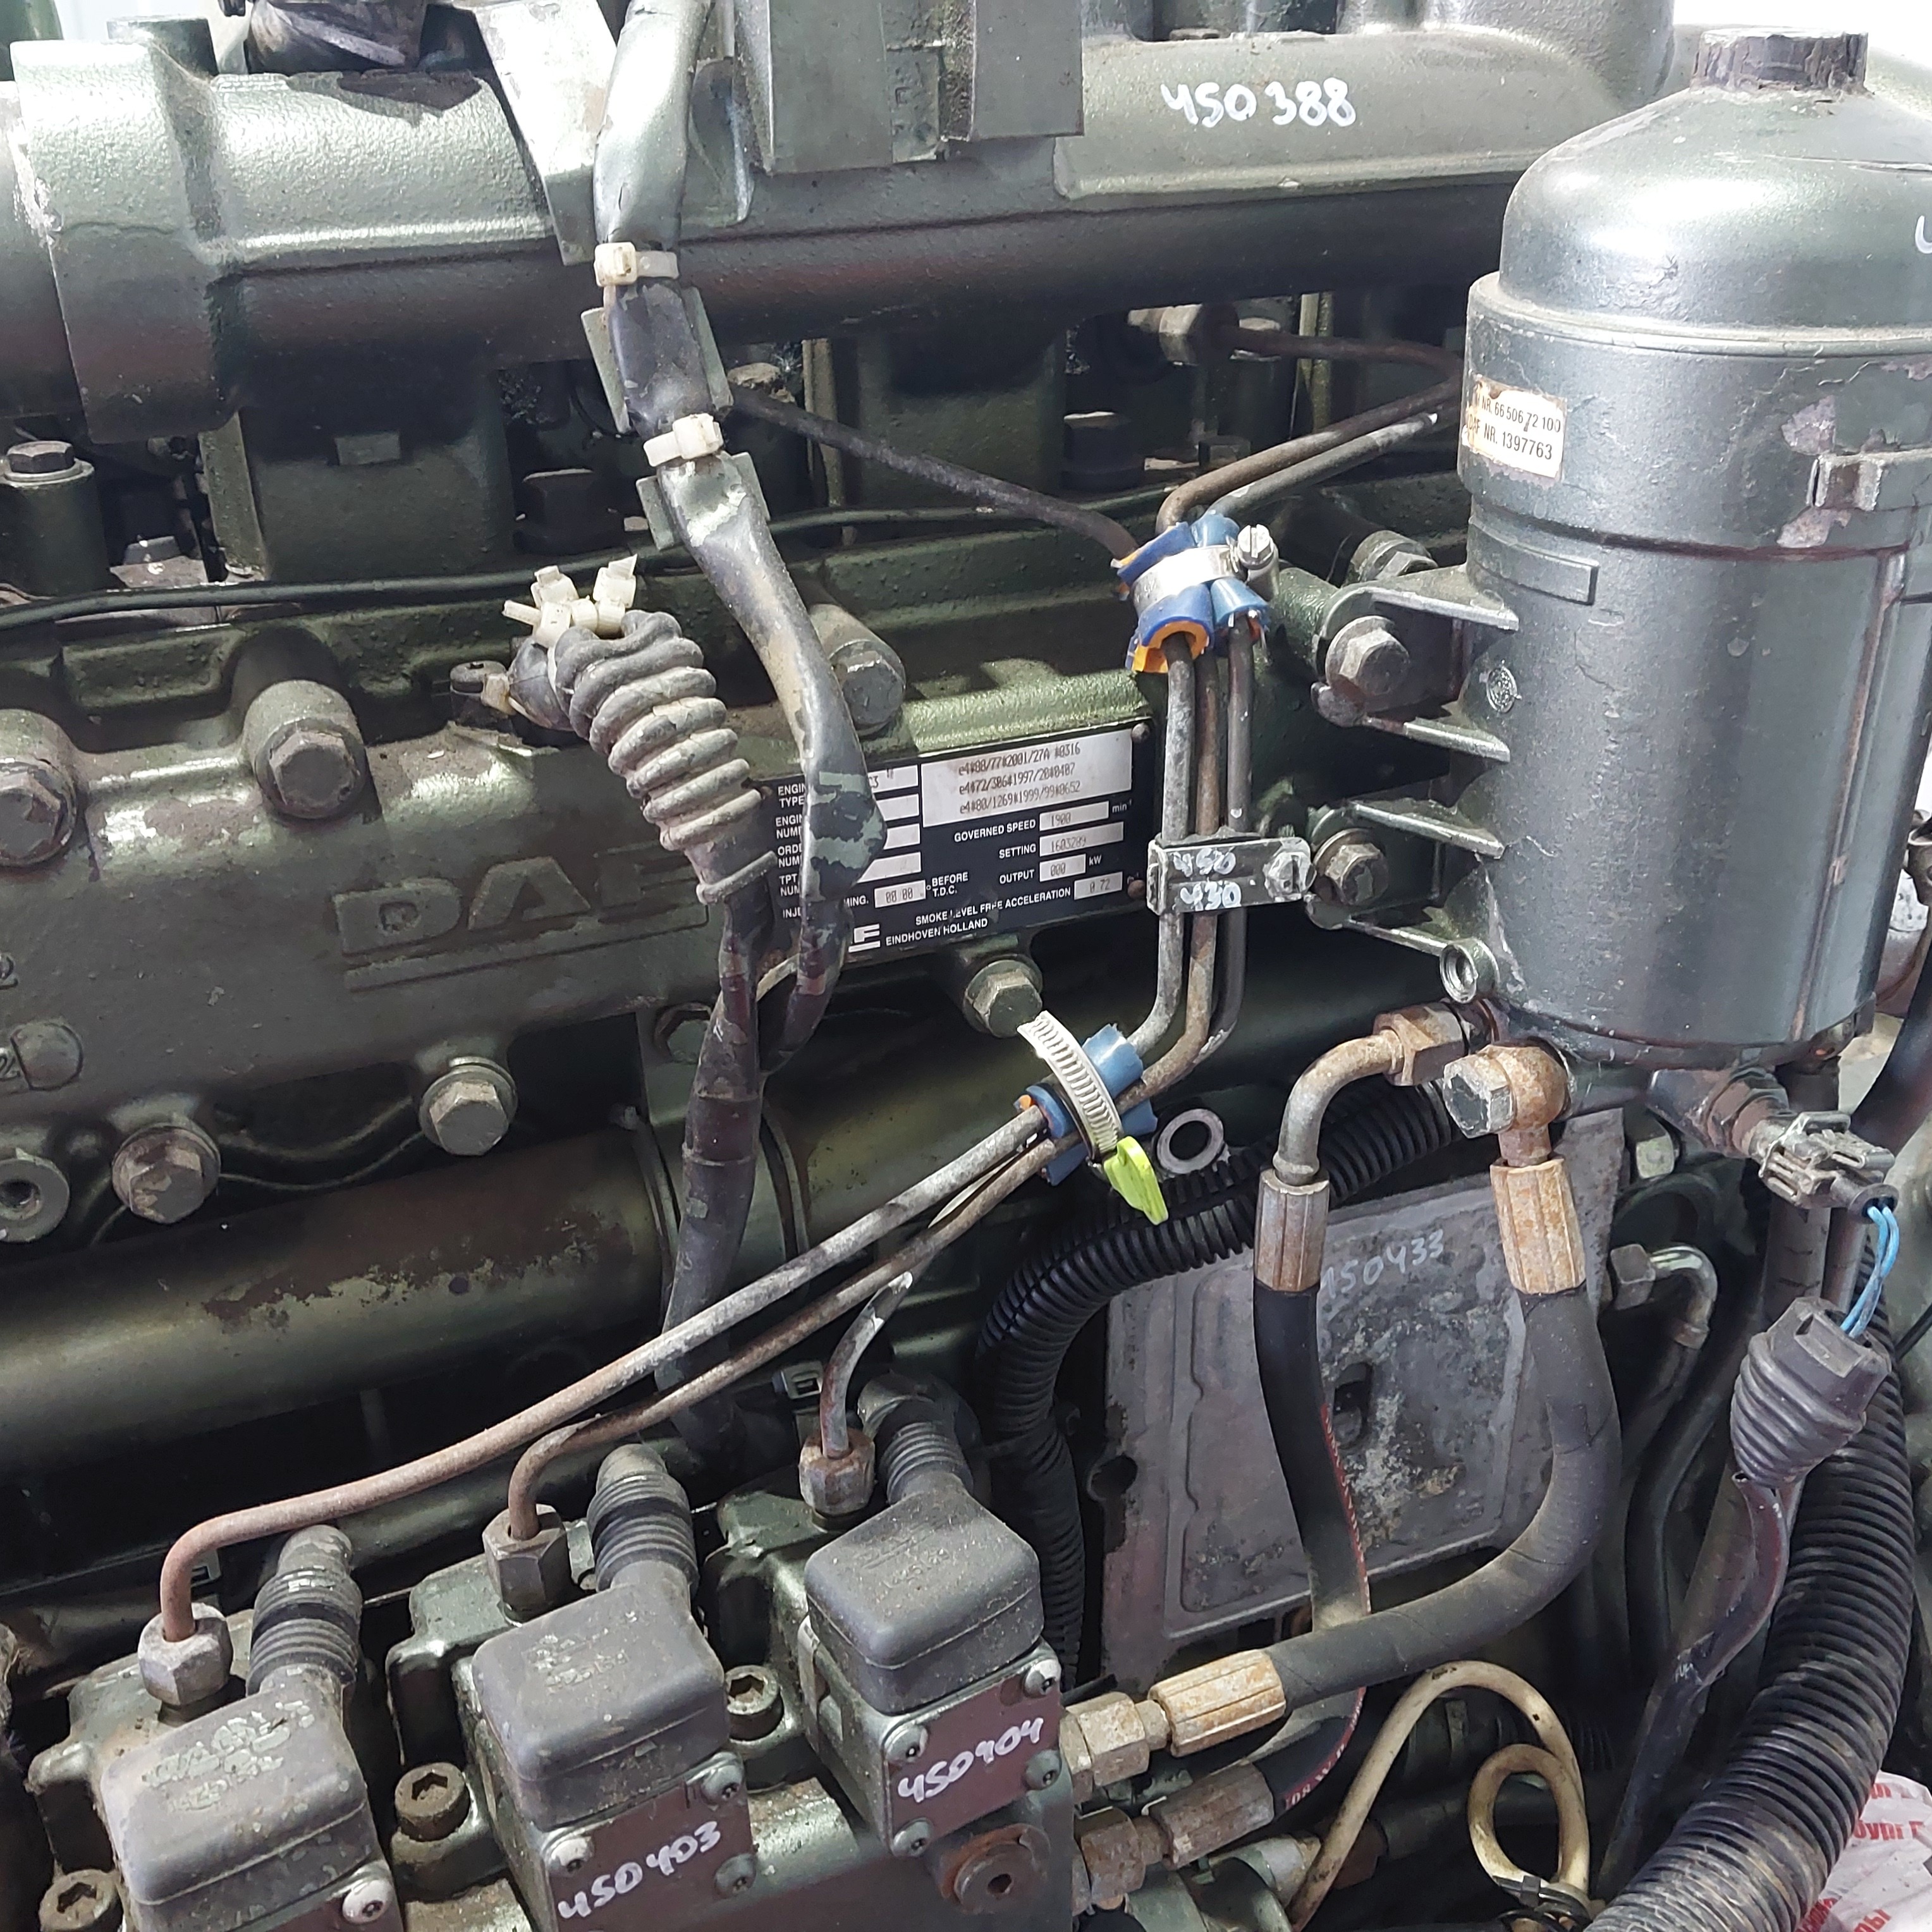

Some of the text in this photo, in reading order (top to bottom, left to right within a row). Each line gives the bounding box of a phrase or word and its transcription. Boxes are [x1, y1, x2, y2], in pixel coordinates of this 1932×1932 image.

[1484, 423, 1498, 444] NR.
[1503, 431, 1553, 460] 1397763
[778, 783, 805, 797] ENGIN
[779, 795, 804, 808] TYPE
[954, 819, 1036, 842] GOVERNED SPEED
[999, 843, 1036, 859] SETTING
[1089, 854, 1102, 865] kW
[779, 874, 797, 885] TPT
[932, 872, 969, 887] BEFORE
[1000, 869, 1035, 884] OUTPUT
[932, 886, 957, 898] T.D.C.
[915, 910, 948, 926] SMOKE
[1005, 887, 1071, 909] ACCELERATION
[886, 918, 988, 946] EINDHOVEN HOLLAND
